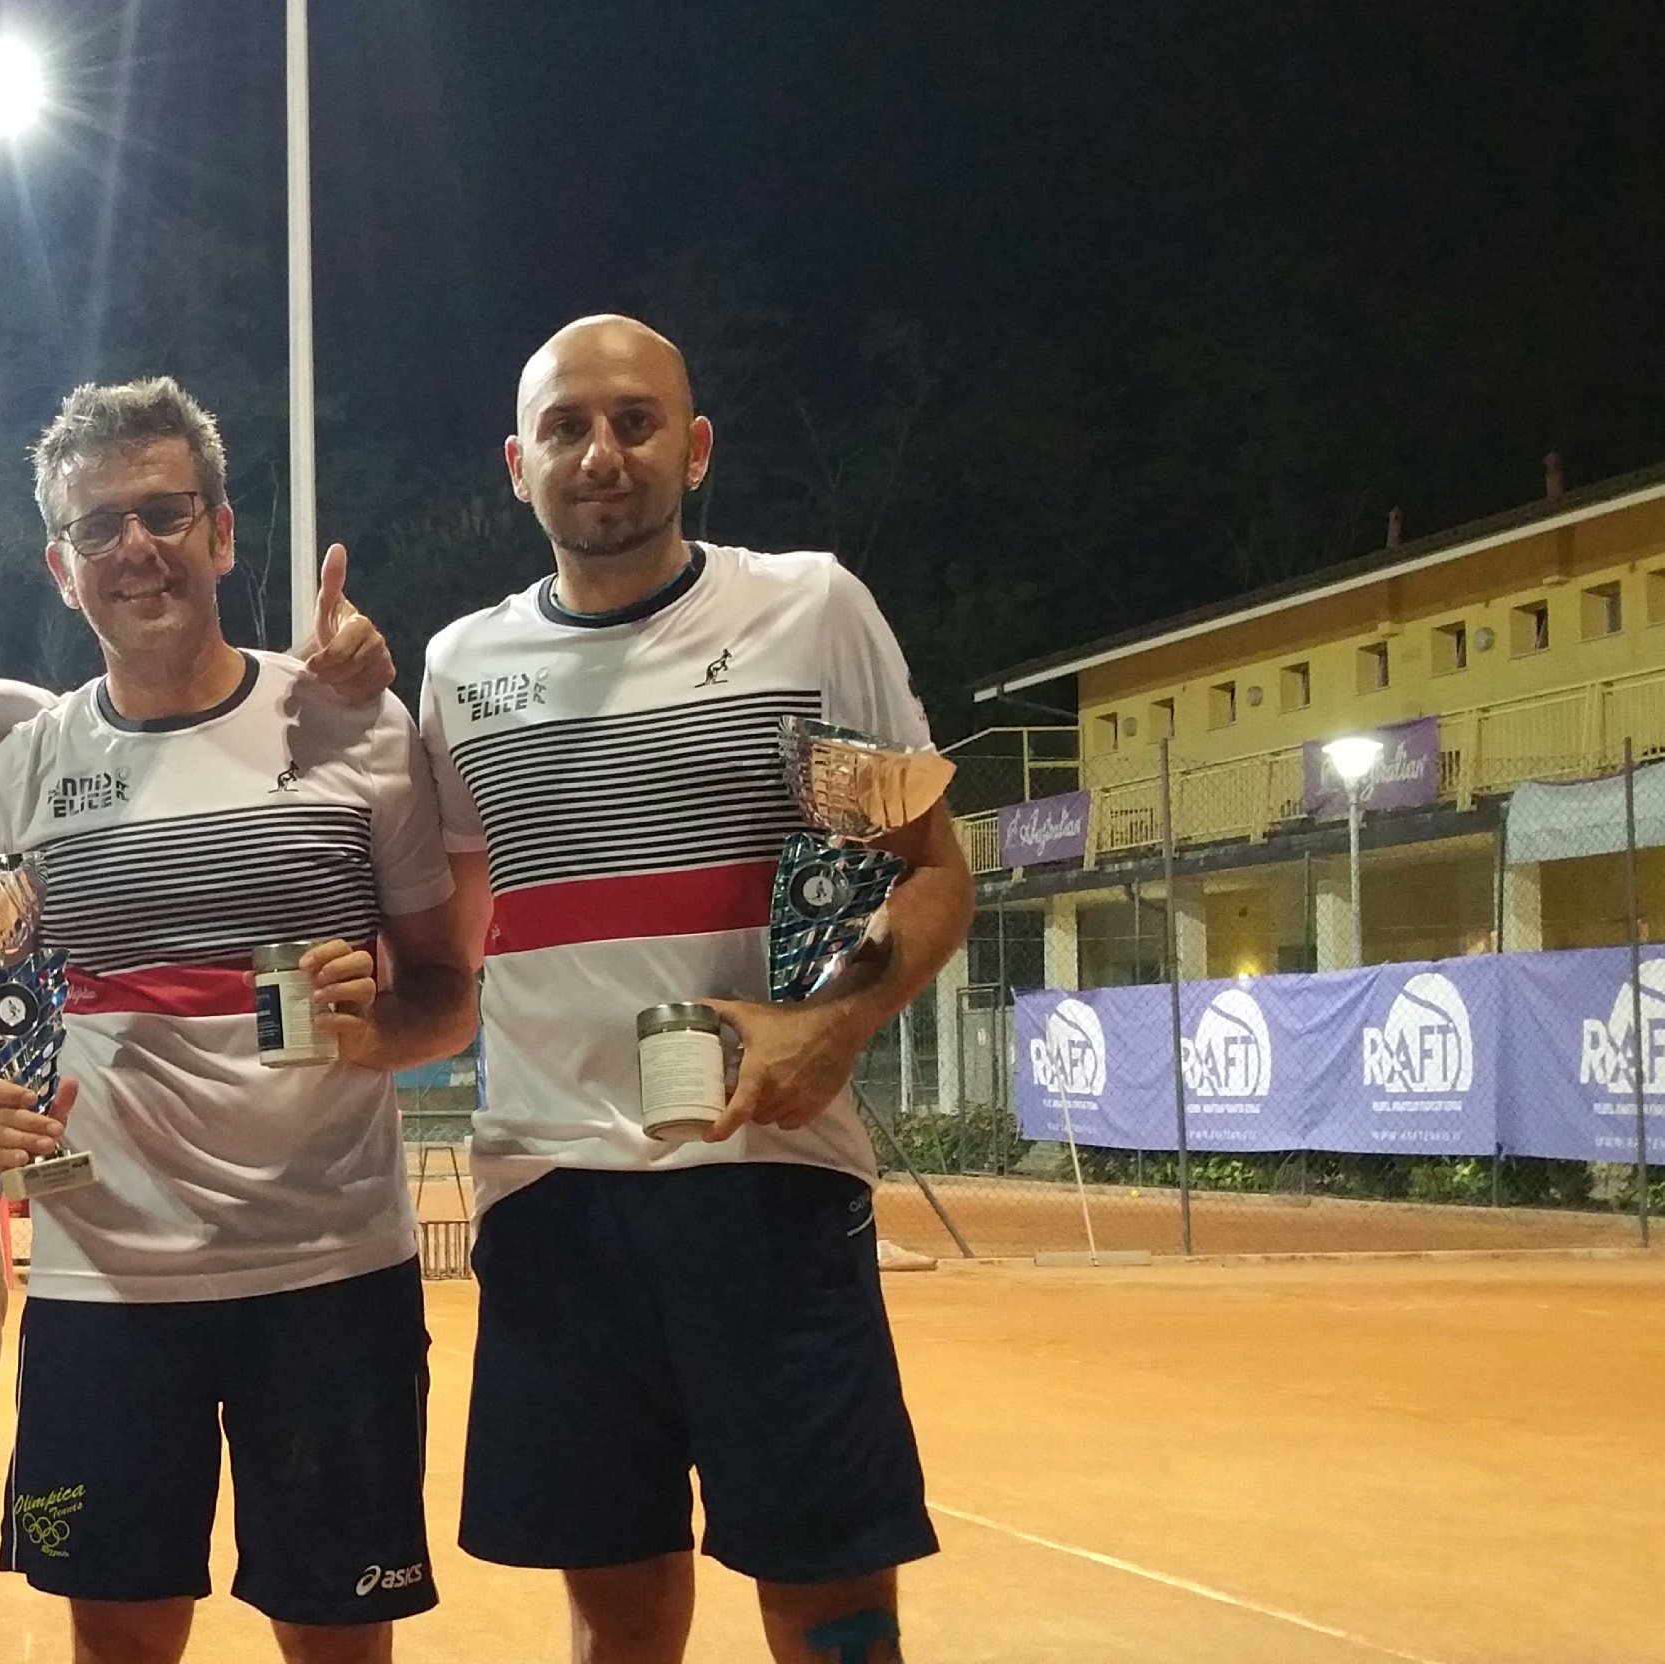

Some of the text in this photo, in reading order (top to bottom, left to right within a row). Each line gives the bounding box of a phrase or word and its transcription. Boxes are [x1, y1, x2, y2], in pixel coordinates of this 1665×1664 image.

[456, 673, 530, 704] TENNIS
[471, 692, 528, 722] ELITE
[54, 790, 112, 818] ELITE
[1363, 1024, 1455, 1085] RAFT
[1579, 1018, 1665, 1085] RAF
[15, 1484, 86, 1515] Olimpica
[381, 1563, 423, 1589] asics
